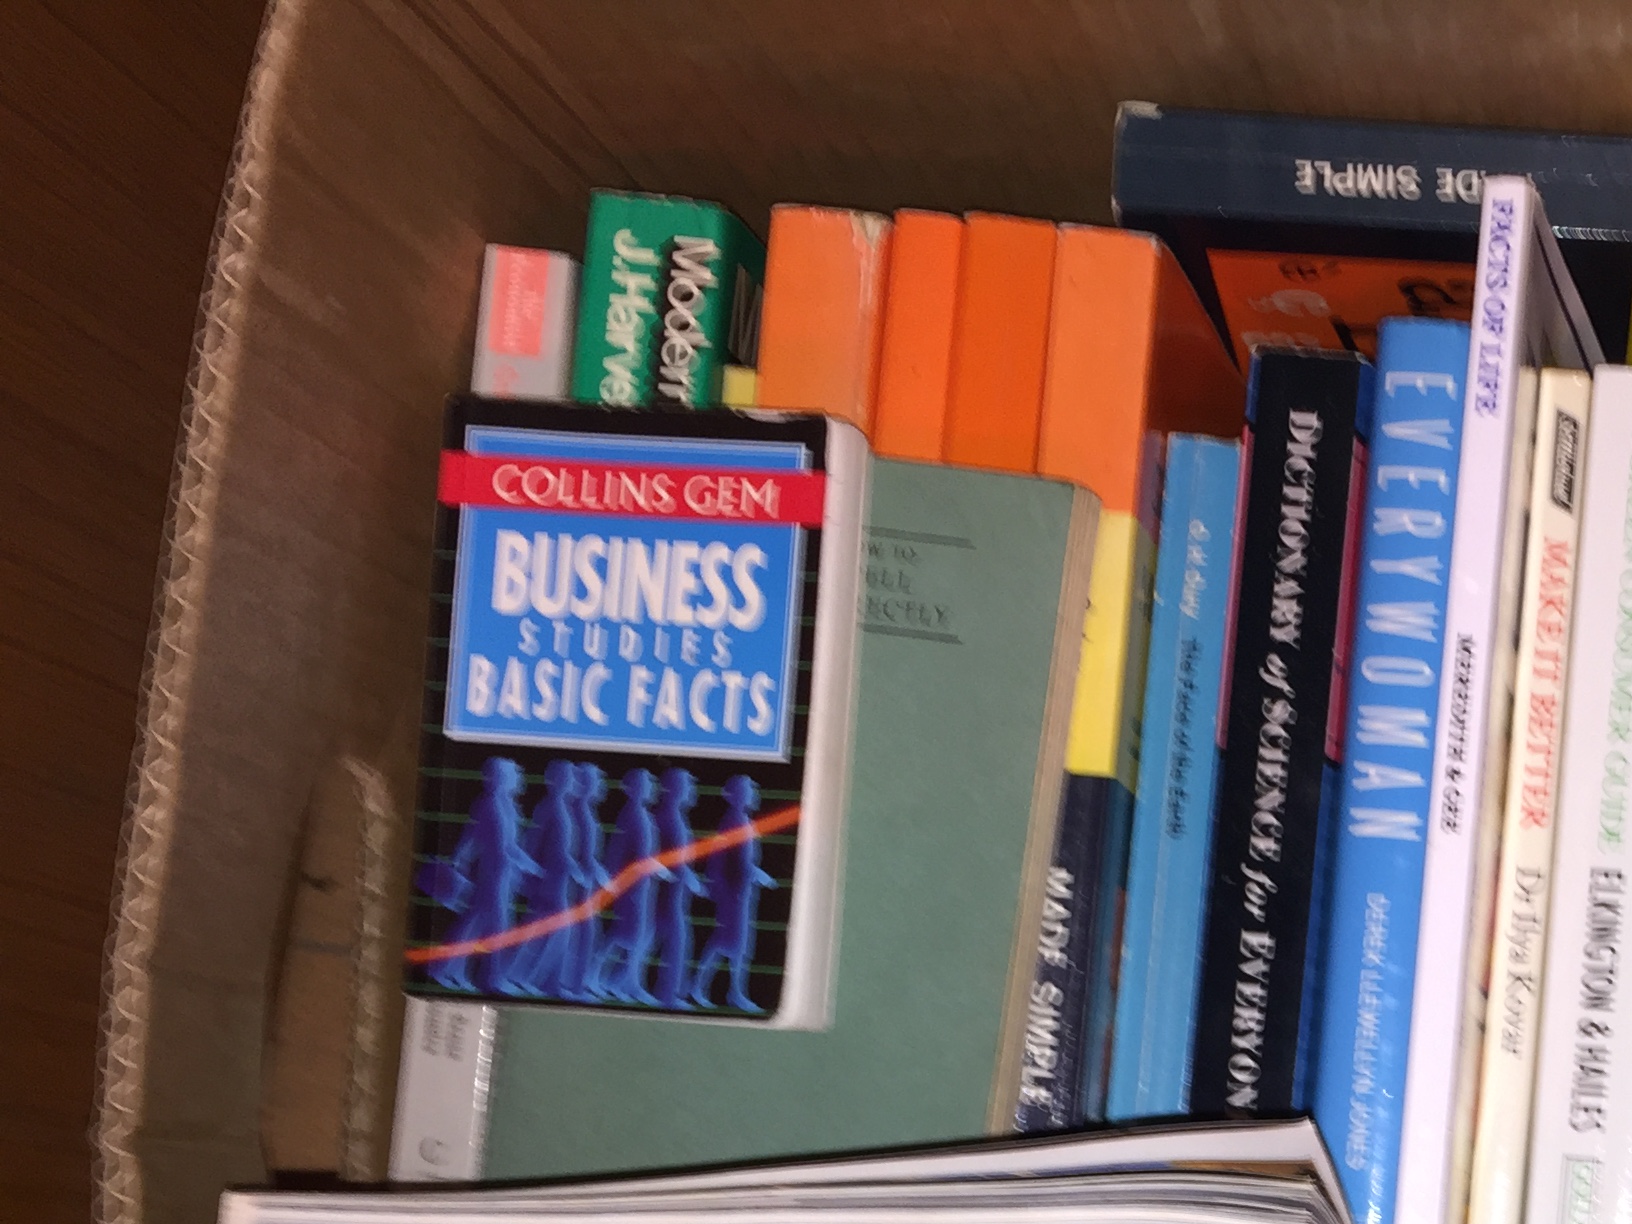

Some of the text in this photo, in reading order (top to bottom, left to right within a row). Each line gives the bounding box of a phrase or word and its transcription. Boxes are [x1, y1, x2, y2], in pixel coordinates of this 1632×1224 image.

[1294, 157, 1485, 205] SIMPLE DE
[1473, 198, 1516, 420] FACTS OF LIFE
[492, 463, 782, 519] COLLINS GEM
[491, 527, 769, 633] BUSINESS
[1348, 368, 1458, 842] EVERYWOMAN
[1534, 537, 1570, 645] MAKE
[517, 616, 734, 668] STUDIES
[1531, 647, 1561, 687] IT
[465, 653, 777, 736] BASIC FACTS
[1226, 408, 1325, 1111] DICTIONARY of SCIENCE for EVERYON
[1518, 692, 1558, 833] BETTER
[1597, 752, 1632, 854] GUIDE
[1362, 892, 1391, 966] DEREK
[1513, 866, 1545, 905] Dr
[1018, 866, 1078, 1109] MADE SIMPLE
[1500, 969, 1537, 1061] Kovar
[1567, 866, 1627, 1135] ELKINGTON & HAILES
[1345, 1101, 1372, 1171] JONES
